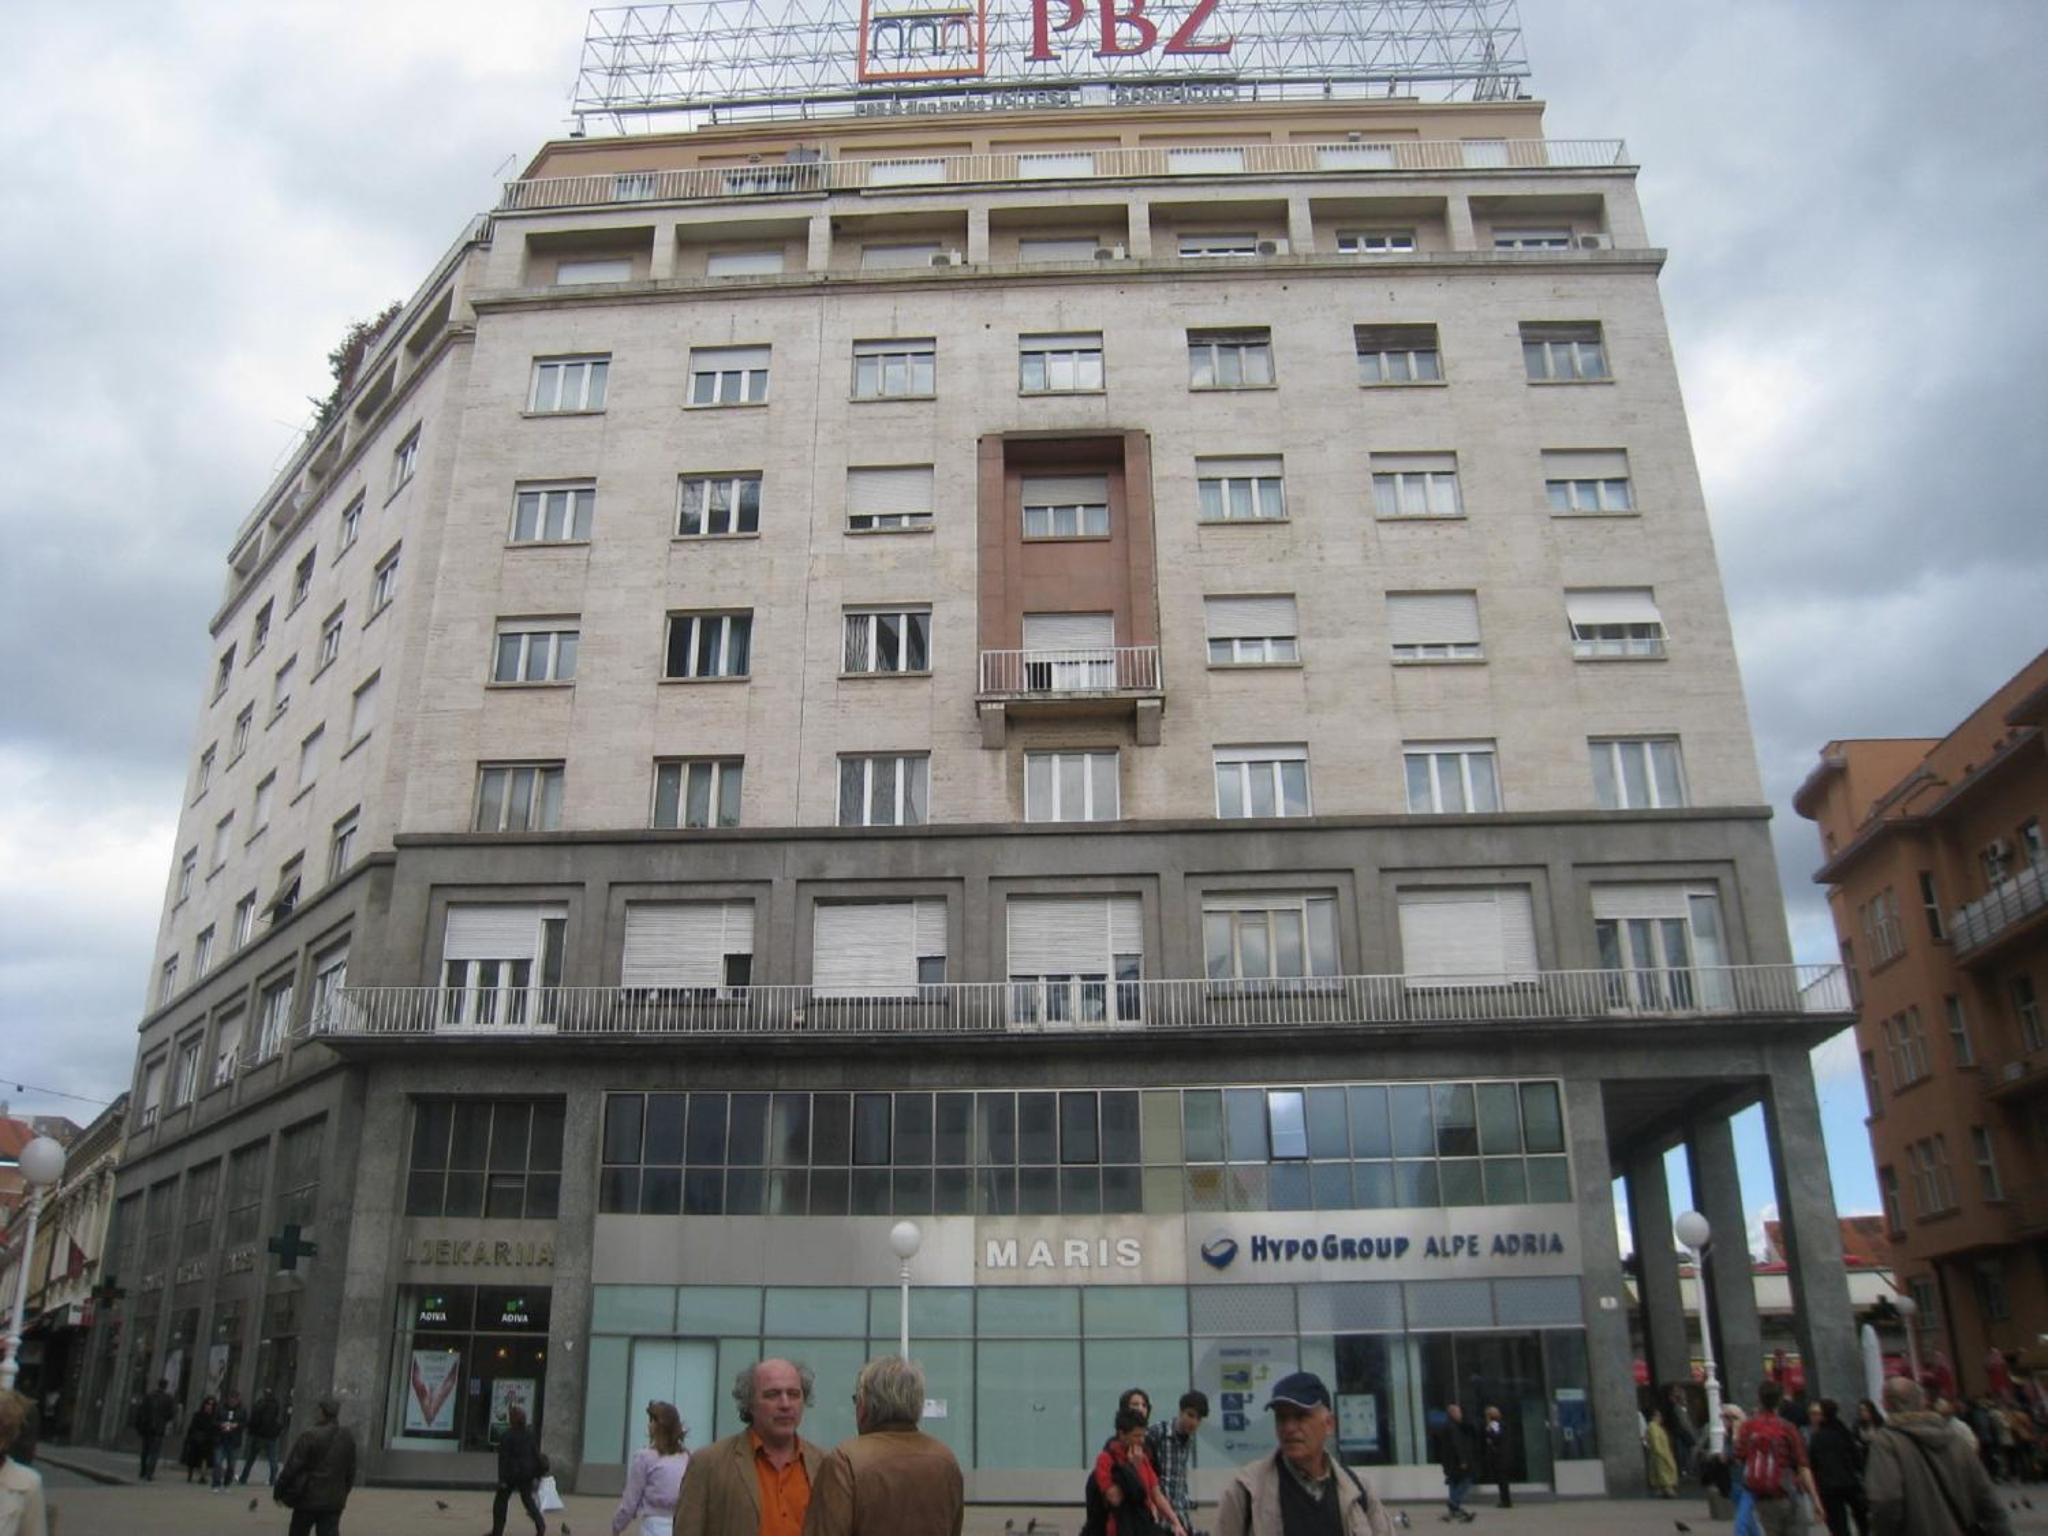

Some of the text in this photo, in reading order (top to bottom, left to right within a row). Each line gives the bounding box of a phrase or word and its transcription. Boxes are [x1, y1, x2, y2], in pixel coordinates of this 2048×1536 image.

[1024, 0, 1233, 61] PBZ
[403, 1239, 556, 1267] LJEKARNA
[986, 1238, 1142, 1268] MARIS
[1423, 1235, 1480, 1259] ALPE
[1491, 1232, 1565, 1257] ADRIA
[419, 1311, 447, 1322] ADIVA
[501, 1313, 529, 1324] ADIVA
